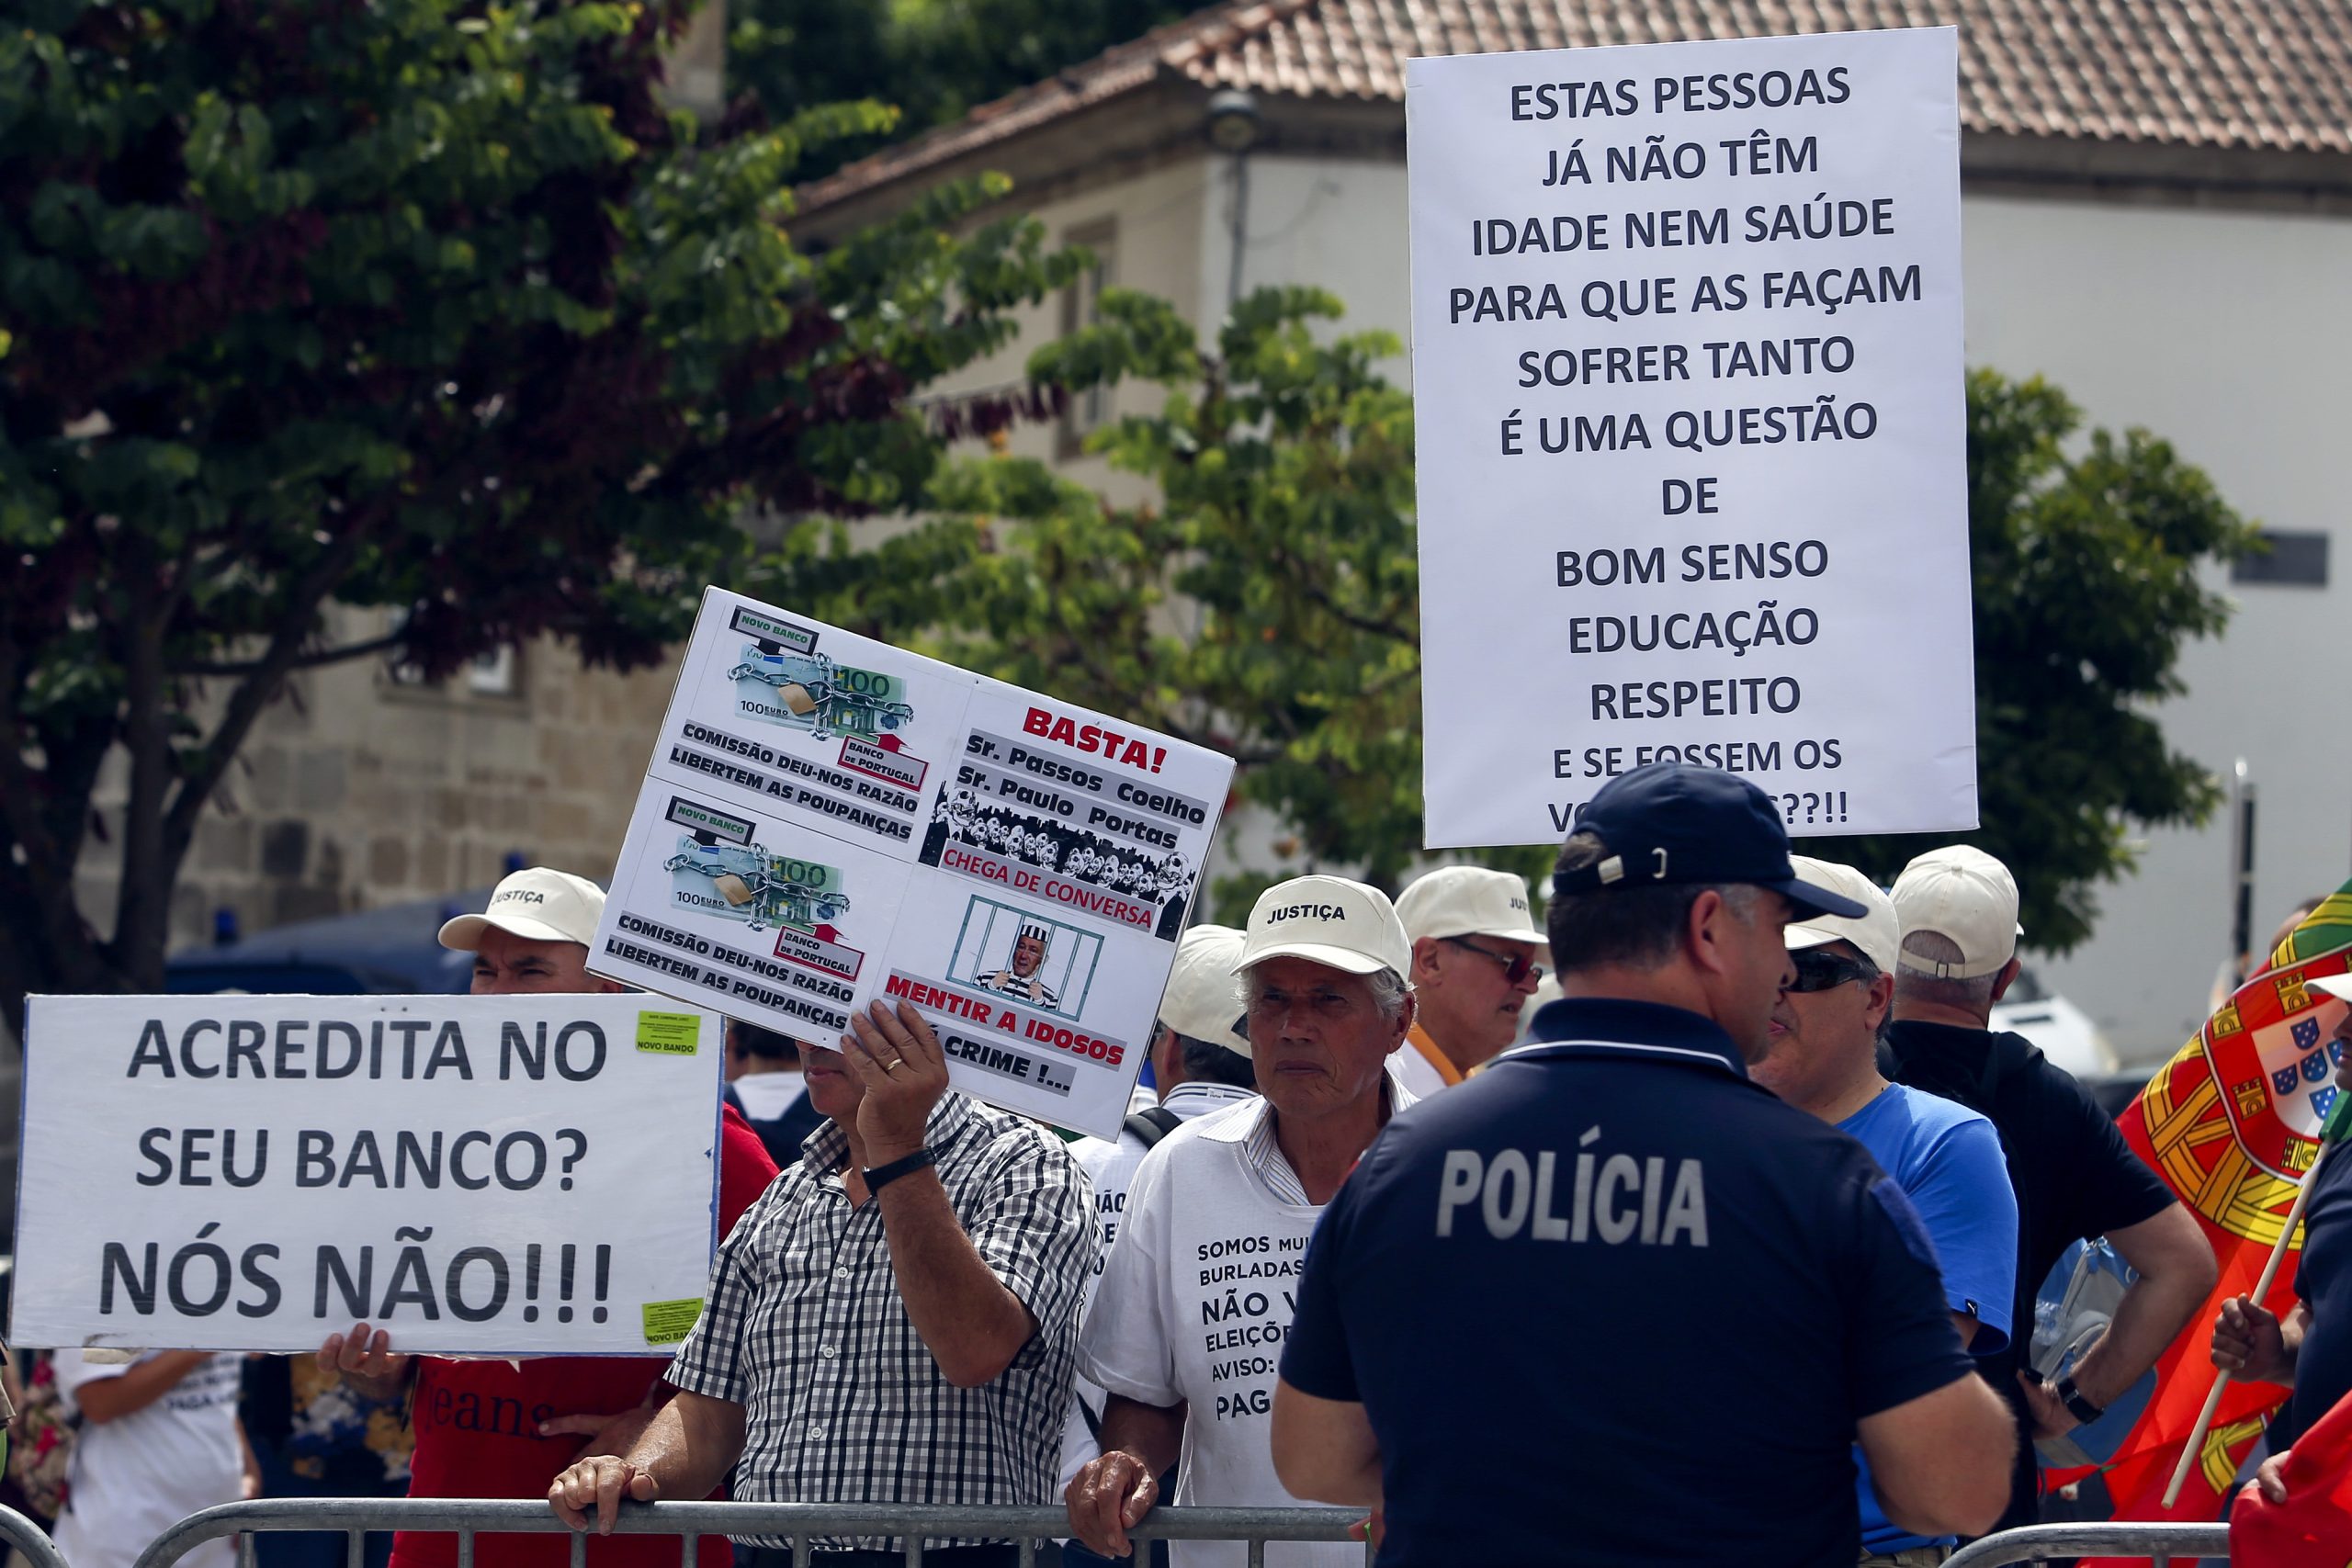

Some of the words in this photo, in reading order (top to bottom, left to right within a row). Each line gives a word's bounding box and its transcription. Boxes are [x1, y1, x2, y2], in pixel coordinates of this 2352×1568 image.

[1511, 79, 1638, 120] ESTAS
[1655, 67, 1850, 113] PESSOAS
[1543, 139, 1592, 186] JÁ
[1607, 135, 1706, 183] NÃO
[1720, 129, 1817, 176] TÊM
[1474, 214, 1609, 255] IDADE
[1625, 209, 1728, 249] NEM
[1745, 192, 1894, 243] SAÚDE
[1451, 284, 1567, 324] PARA
[1581, 277, 1676, 322] QUE
[1691, 274, 1747, 312] AS
[1763, 265, 1921, 315] FAÇAM
[1519, 344, 1690, 388] SOFRER
[1702, 336, 1854, 378] TANTO
[1501, 409, 1523, 456] É
[1540, 413, 1652, 454] UMA
[1666, 394, 1877, 453] QUESTÃO
[1663, 478, 1718, 515] DE
[1557, 547, 1665, 587] BOM
[1681, 540, 1828, 582] SENSO
[741, 615, 771, 631] NOVO
[772, 626, 808, 644] BANCO
[1569, 600, 1818, 657] EDUCAÇÃO
[1591, 676, 1800, 720] RESPEITO
[848, 742, 884, 760] BANCO
[1023, 707, 1167, 774] BASTA!
[1555, 750, 1572, 778] E
[1584, 748, 1624, 780] SE
[1794, 739, 1841, 770] OS
[670, 747, 763, 790] LIBERTEM
[766, 781, 794, 799] AS
[797, 790, 911, 840] POUPANÇAS
[683, 724, 774, 763] COMISSÃO
[776, 755, 854, 791] DEU-NOS
[856, 782, 918, 812] RAZÃO
[844, 755, 856, 763] DE
[855, 758, 915, 784] PORTUGAL
[967, 735, 1000, 761] Sr.
[1008, 748, 1102, 792] Passos
[1117, 783, 1205, 824] Coelho
[677, 807, 707, 821] NOVO
[708, 817, 744, 834] BANCO
[956, 766, 990, 791] Sr.
[999, 778, 1074, 817] Paulo
[1088, 807, 1178, 850] Portas
[492, 890, 544, 905] JUSTIÇA
[944, 849, 1008, 883] CHEGA
[1013, 871, 1041, 893] DE
[1045, 881, 1151, 929] CONVERSA
[1267, 905, 1345, 924] JUSTIÇA
[618, 915, 709, 954] COMISSÃO
[712, 946, 789, 981] DEU-NOS
[792, 973, 854, 1002] RAZÃO
[780, 945, 792, 954] DE
[791, 949, 850, 974] PORTUGAL
[785, 932, 820, 951] BANCO
[605, 939, 699, 981] LIBERTEM
[701, 972, 729, 990] AS
[732, 981, 847, 1030] POUPANÇAS
[885, 975, 991, 1024] MENTIR
[996, 1011, 1016, 1032] A
[1024, 1019, 1125, 1066] IDOSOS
[127, 1020, 473, 1080] ACREDITA
[499, 1021, 606, 1081] NO
[638, 1041, 662, 1050] NOVO
[663, 1043, 694, 1053] BANDO
[944, 1036, 1031, 1078] CRIME
[136, 1127, 268, 1188] SEU
[296, 1128, 587, 1191] BANCO?
[1436, 1124, 1709, 1247] POLÍCIA
[99, 1222, 281, 1318] NÓS
[313, 1226, 611, 1324] NÃO!!!
[1198, 1236, 1270, 1261] SOMOS
[1200, 1259, 1304, 1286] BURLADAS
[1202, 1288, 1271, 1325] NÃO
[1213, 1357, 1274, 1382] AVISO:
